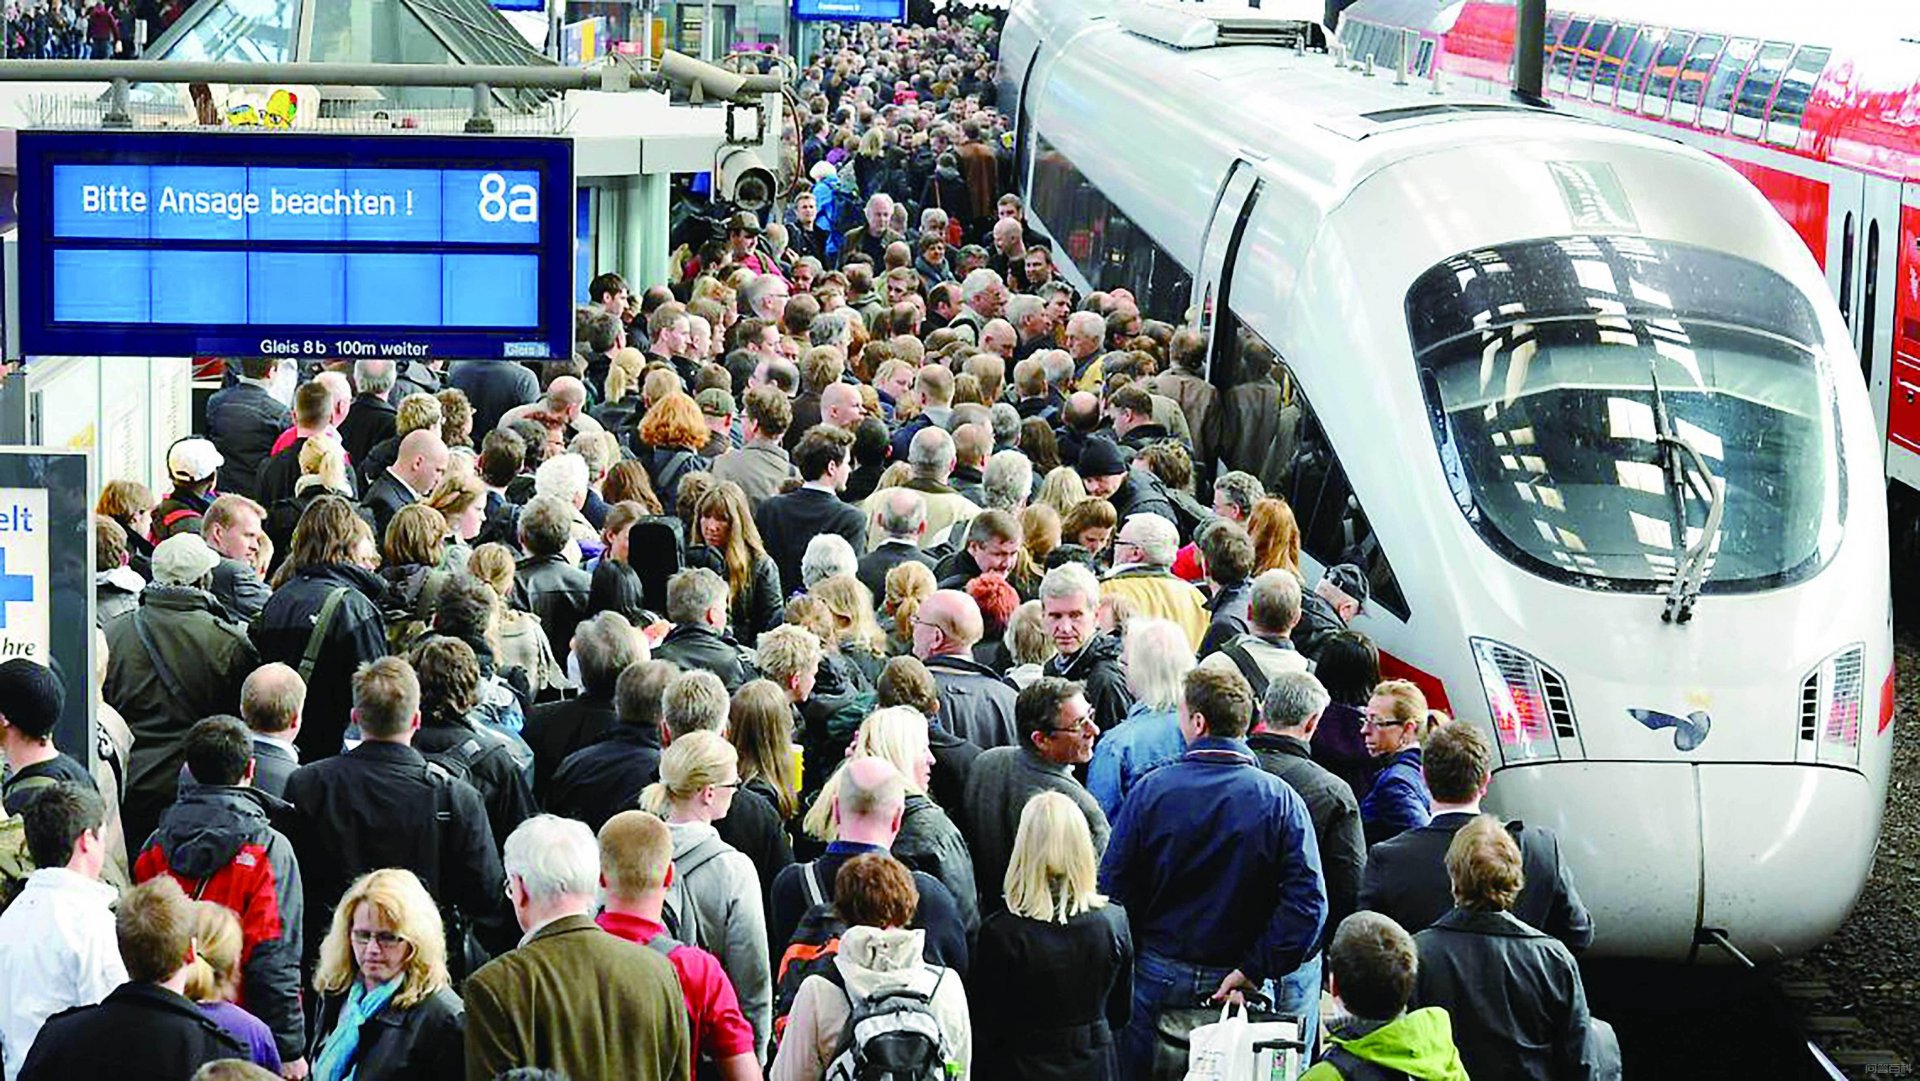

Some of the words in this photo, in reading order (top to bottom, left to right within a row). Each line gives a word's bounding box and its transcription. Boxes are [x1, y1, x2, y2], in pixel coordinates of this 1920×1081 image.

[82, 184, 147, 213] Bitte
[158, 185, 260, 221] Ansage
[270, 187, 397, 217] beachten
[405, 188, 414, 217] !
[478, 172, 539, 224] 8a
[259, 339, 300, 355] Gleis
[334, 340, 377, 356] 100m
[379, 341, 429, 357] weiter
